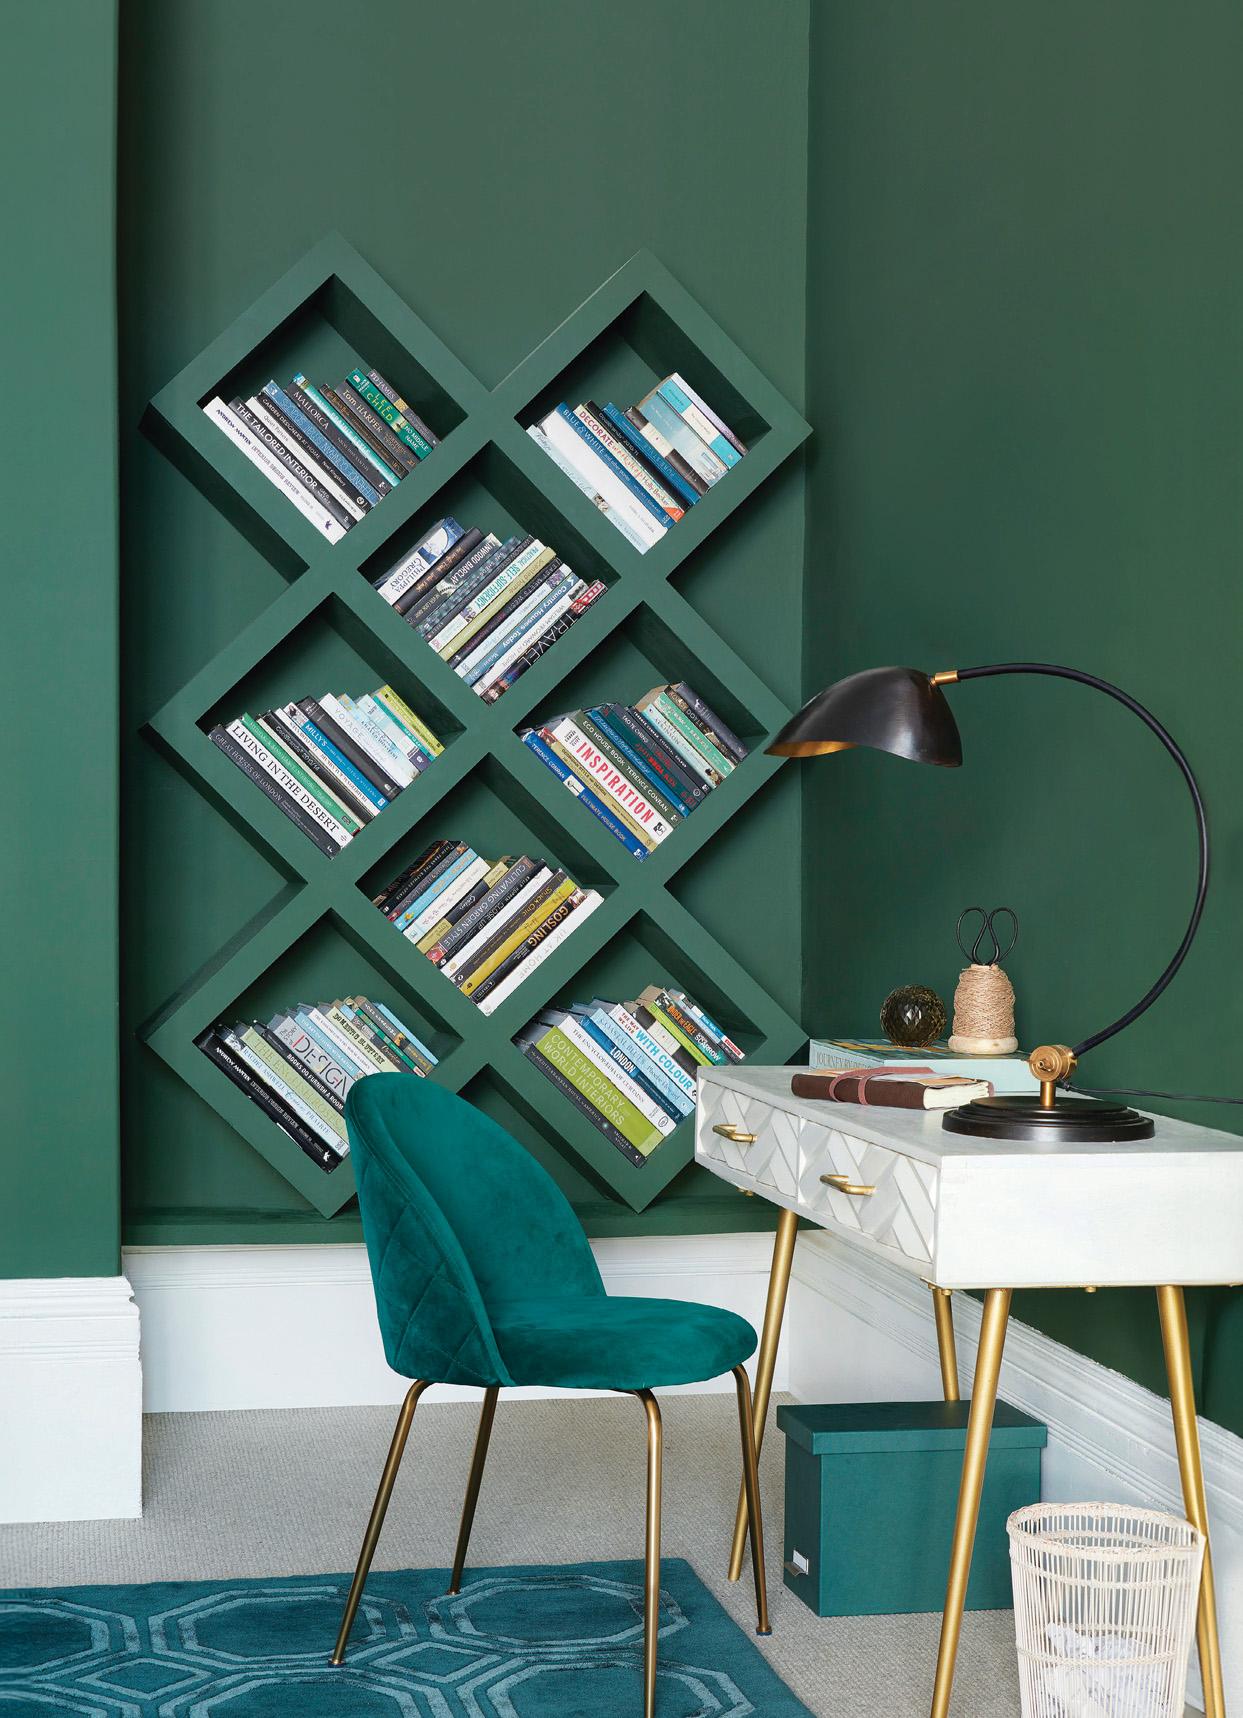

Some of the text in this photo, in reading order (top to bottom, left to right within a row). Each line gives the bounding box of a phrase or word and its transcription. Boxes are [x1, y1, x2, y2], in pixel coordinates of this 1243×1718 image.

[376, 379, 396, 400] JAMES
[292, 390, 330, 430] MALLORCA
[355, 404, 383, 433] HARPER
[365, 392, 393, 421] LEE CHILD
[215, 408, 235, 429] ANDREW
[234, 427, 252, 446] MARTIN
[403, 425, 413, 435] NO
[561, 408, 580, 427] BLUE
[583, 430, 606, 454] WHITE
[235, 403, 252, 421] THE
[248, 417, 287, 457] TAILORED
[283, 453, 318, 489] INTERIOR
[261, 398, 280, 417] GARDEN
[278, 415, 303, 441] DESIGNERS
[300, 438, 308, 446] AT
[306, 444, 320, 459] HOME
[328, 468, 347, 487] Kingsbury
[404, 434, 419, 450] NAME
[410, 433, 428, 451] MIDDLE
[578, 410, 614, 447] DECORATE
[640, 474, 656, 491] Holly
[652, 487, 671, 507] Becker
[470, 539, 496, 564] LINWOOD
[516, 544, 539, 567] PRACTICAL
[388, 556, 425, 595] PHILIPPA GREGORY
[448, 559, 474, 585] BARCLAY
[507, 562, 556, 611] EAST MEETS WEST
[541, 583, 567, 609] Country
[519, 607, 544, 631] Houses
[543, 603, 565, 625] WILLIAM
[500, 628, 521, 649] Today
[516, 609, 577, 671] TRAVEL
[520, 622, 545, 648] YEOWARD
[500, 651, 517, 667] HOME
[333, 707, 364, 740] VOYAGE
[621, 714, 631, 725] TAO
[633, 727, 649, 743] CHING
[685, 708, 704, 728] DOYLE
[304, 723, 328, 747] MILLY'S
[214, 732, 282, 801] GREAT HOUSES OF LONDON
[530, 742, 566, 779] TERENCE CONRAN
[581, 720, 594, 733] ECO
[592, 731, 611, 751] HOUSE
[609, 749, 626, 766] BOOK
[624, 765, 648, 790] TERENCE
[646, 788, 669, 812] CONRAN
[231, 724, 268, 762] LIVING
[267, 760, 281, 775] IN
[277, 771, 301, 796] THE
[299, 793, 339, 834] DESERT
[574, 741, 655, 824] INSPIRATION
[612, 827, 626, 841] BOOK
[485, 863, 526, 904] CULTIVATING
[460, 900, 489, 929] GARDEN
[485, 900, 504, 920] CLOSE
[520, 885, 552, 917] Shack Chic
[443, 926, 463, 946] STYLE
[475, 918, 487, 929] UP
[526, 904, 569, 947] GOSLING
[552, 928, 566, 941] UK
[540, 940, 553, 954] AT
[515, 951, 542, 979] HOME
[332, 1011, 360, 1041] DOMESTIC
[617, 1012, 639, 1034] THE WAY WE LIVE
[682, 1020, 697, 1036] EAGLE
[252, 1038, 275, 1062] THE
[599, 1016, 629, 1047] COASTAL
[645, 1064, 664, 1083] Phoebe
[660, 1080, 680, 1100] Howard
[609, 1046, 635, 1073] LONDON
[634, 1030, 661, 1057] WITH
[657, 1053, 693, 1090] COLOUR
[693, 1033, 721, 1062] SCARROW
[291, 1033, 354, 1098] DESIGN
[541, 1032, 626, 1126] CONTEMPORARY WORLD INTERIORS
[572, 1028, 583, 1039] THE
[621, 1079, 645, 1103] CURTAINS
[214, 1045, 234, 1066] ANDREW
[232, 1063, 250, 1082] MARTIN
[249, 1080, 270, 1101] INTERIOR
[281, 1111, 299, 1129] REVIEW
[286, 1052, 304, 1070] BOOKS
[300, 1066, 310, 1077] DO
[307, 1073, 327, 1094] FURNISH
[328, 1095, 344, 1111] ROOM
[261, 1067, 285, 1091] ASHWELL
[304, 1109, 330, 1136] PRAIRIE
